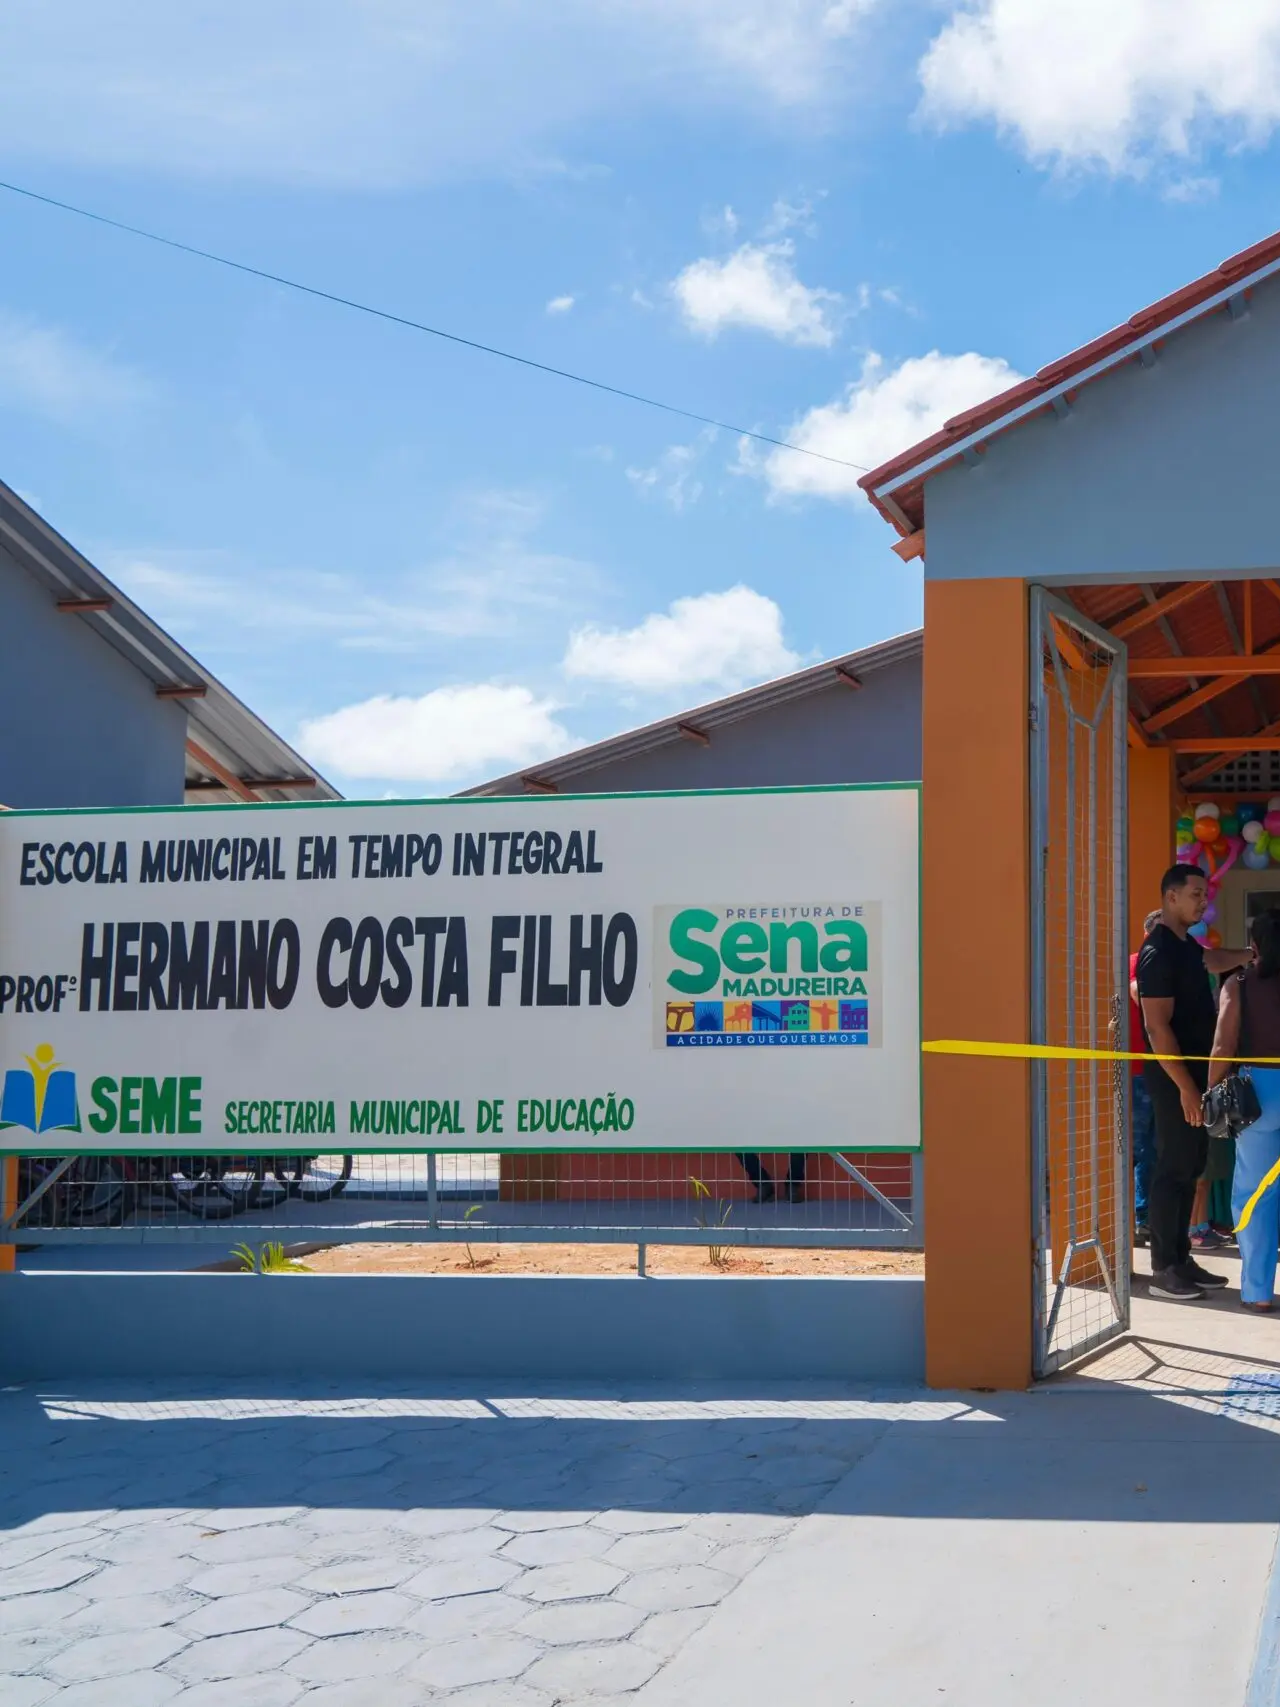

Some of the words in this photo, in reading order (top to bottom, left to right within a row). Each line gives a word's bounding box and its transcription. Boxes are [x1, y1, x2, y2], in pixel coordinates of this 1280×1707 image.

[20, 841, 127, 886] ESCOLA
[139, 836, 286, 884] MUNICIPAL
[297, 835, 337, 881] EM
[348, 833, 443, 879] TEMPO
[452, 829, 604, 876] INTEGRAL
[726, 906, 835, 919] PREFEITURA
[841, 906, 864, 917] DE
[79, 918, 301, 1012] HERMANO
[316, 915, 469, 1010] COSTA
[487, 911, 638, 1008] FILHO
[667, 908, 868, 995] Sena
[722, 976, 868, 997] MADUREIRA
[689, 1035, 742, 1045] CIDADE
[747, 1035, 775, 1045] QUE
[780, 1034, 858, 1045] QUEREMOS
[88, 1076, 202, 1134] SEME
[224, 1100, 336, 1134] SECRETARIA
[350, 1099, 466, 1135] MUNICIPAL
[476, 1099, 505, 1134] DE
[517, 1092, 635, 1137] EDUCAÇÃO
